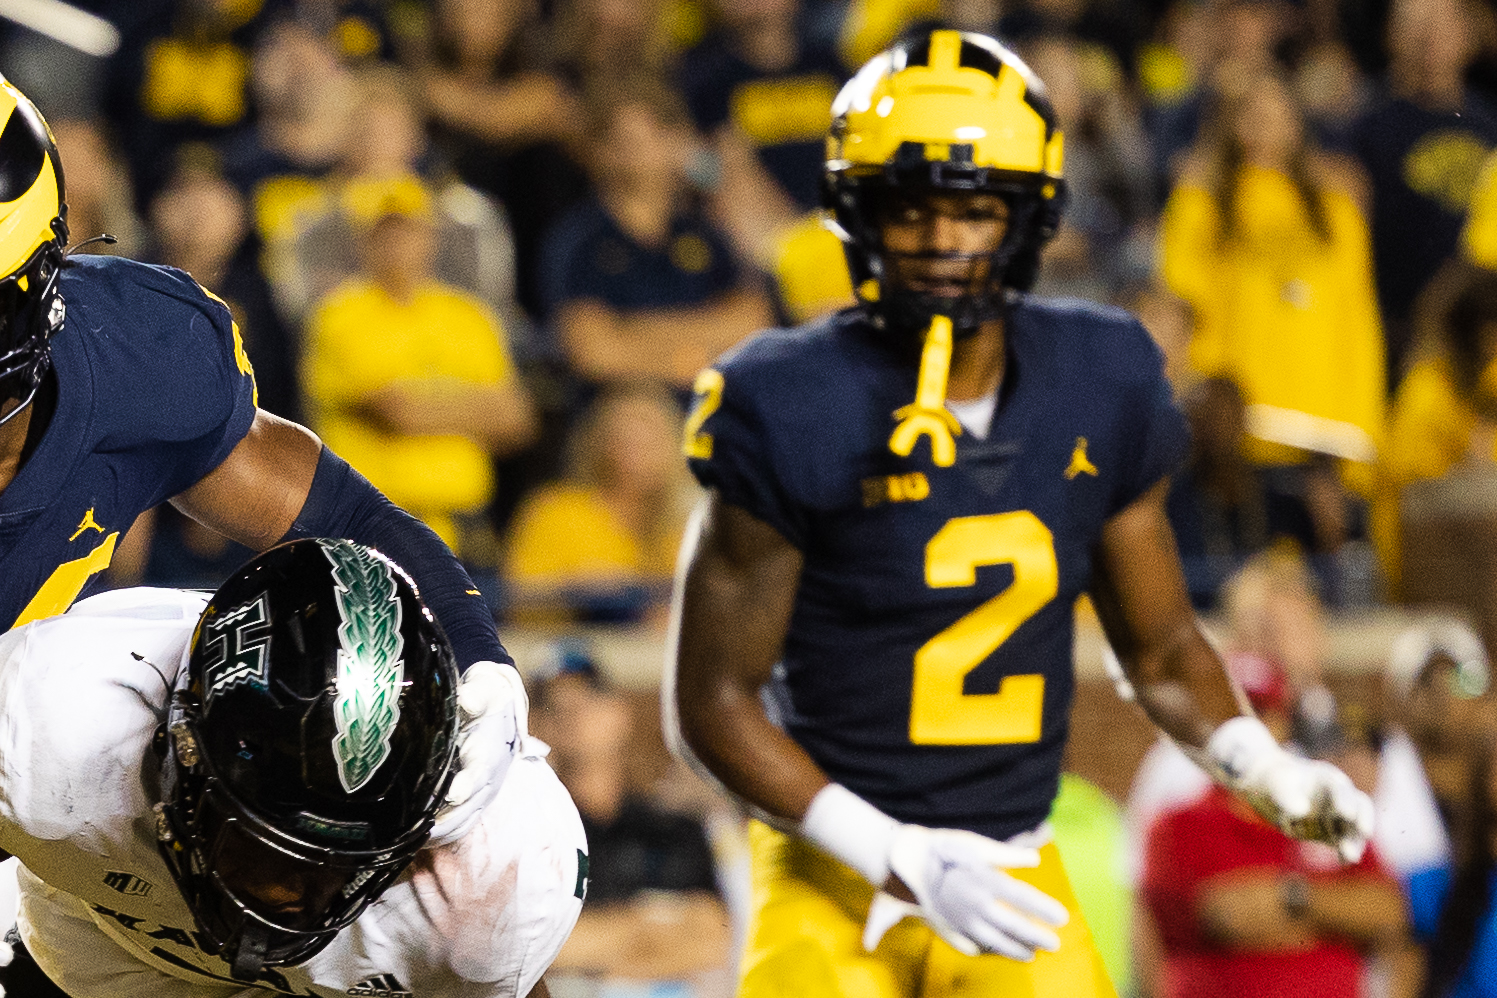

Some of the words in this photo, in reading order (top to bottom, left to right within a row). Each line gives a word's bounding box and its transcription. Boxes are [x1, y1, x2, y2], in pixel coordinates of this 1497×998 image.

[684, 368, 726, 460] 2
[203, 590, 273, 705] H
[909, 510, 1059, 746] 2
